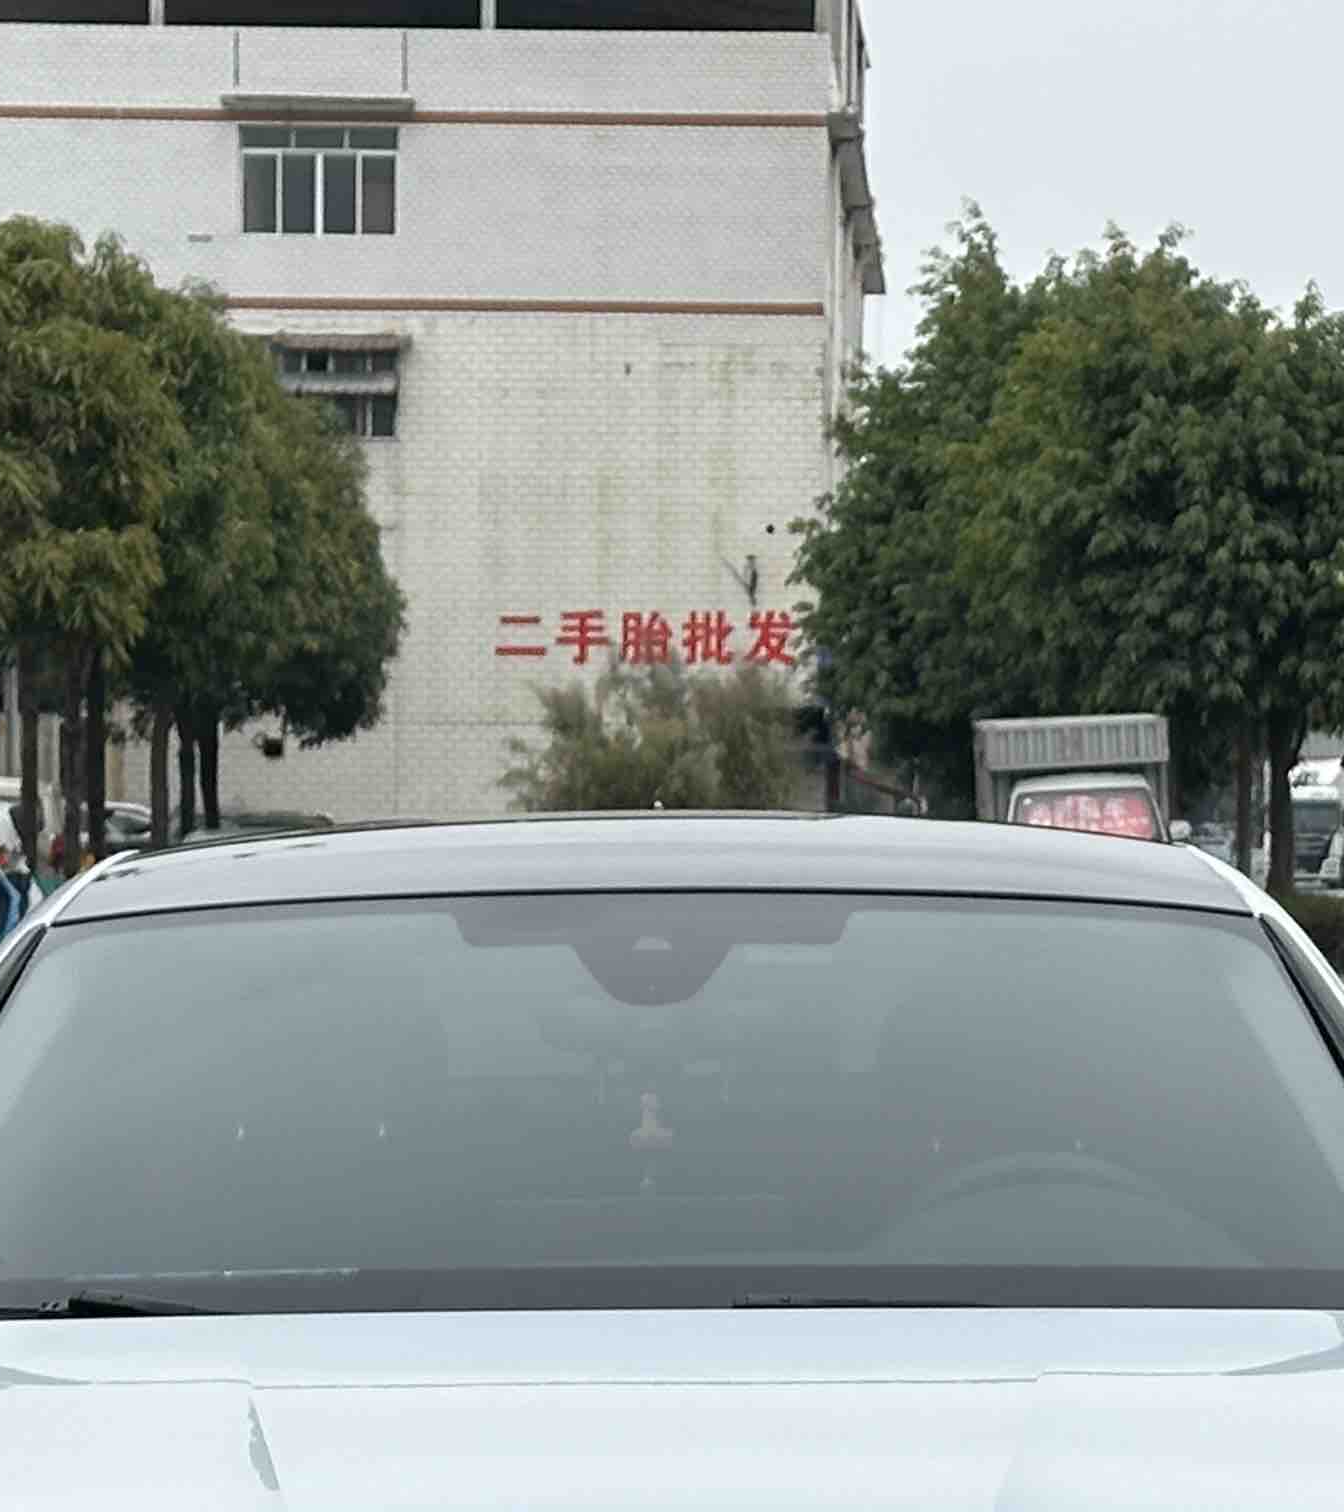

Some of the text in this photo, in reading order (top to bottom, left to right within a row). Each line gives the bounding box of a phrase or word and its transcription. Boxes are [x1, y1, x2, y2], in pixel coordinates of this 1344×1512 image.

[495, 609, 798, 666] 二手胎批发
